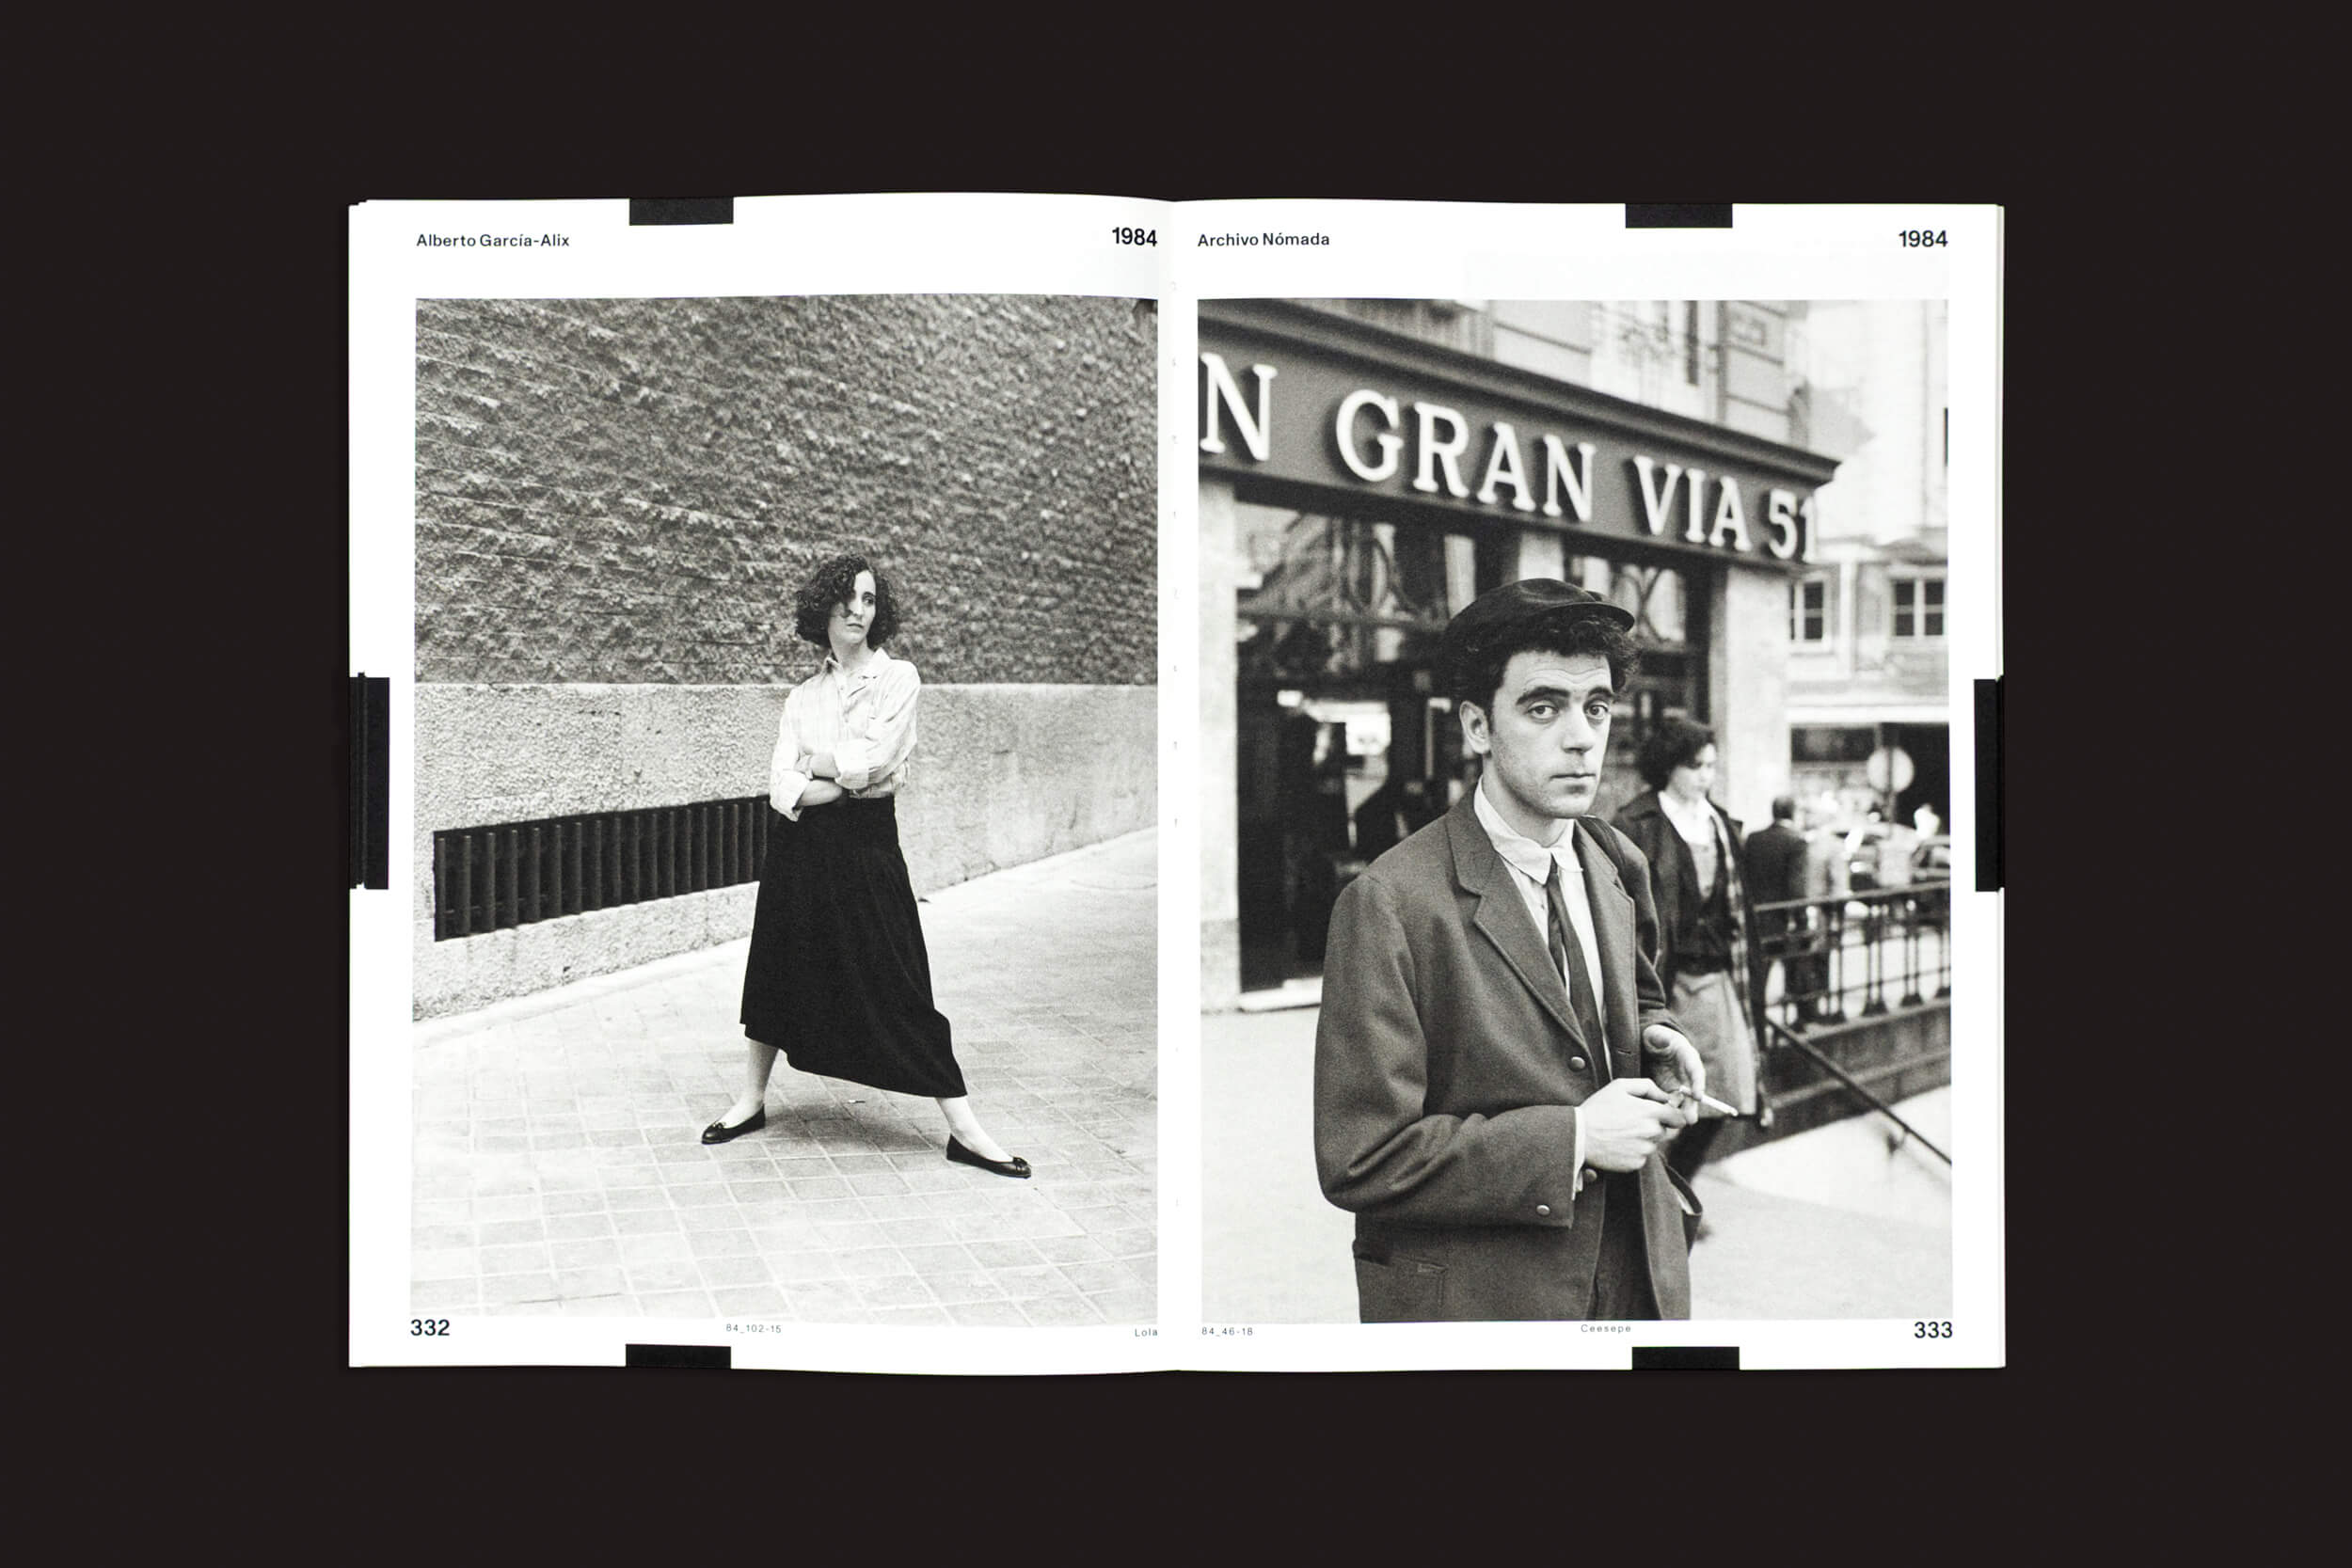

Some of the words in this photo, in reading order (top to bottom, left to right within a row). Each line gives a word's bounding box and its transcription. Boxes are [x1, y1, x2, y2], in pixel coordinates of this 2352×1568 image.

[416, 232, 477, 247] Alberto
[479, 232, 570, 247] García-Alix
[1111, 226, 1158, 247] 1984
[1197, 232, 1259, 247] Archivo
[1263, 231, 1330, 246] Nómada
[1898, 230, 1949, 248] 1984
[1200, 352, 1277, 462] N
[1335, 388, 1597, 524] GRAN
[1632, 455, 1752, 551] VIA
[1767, 490, 1818, 562] 51
[409, 1318, 451, 1337] 332
[725, 1323, 782, 1334] 84_102-15
[1134, 1327, 1158, 1338] Lola
[1201, 1326, 1253, 1337] 84_46-18
[1581, 1323, 1631, 1335] Ceesepe
[1914, 1321, 1953, 1339] 333
